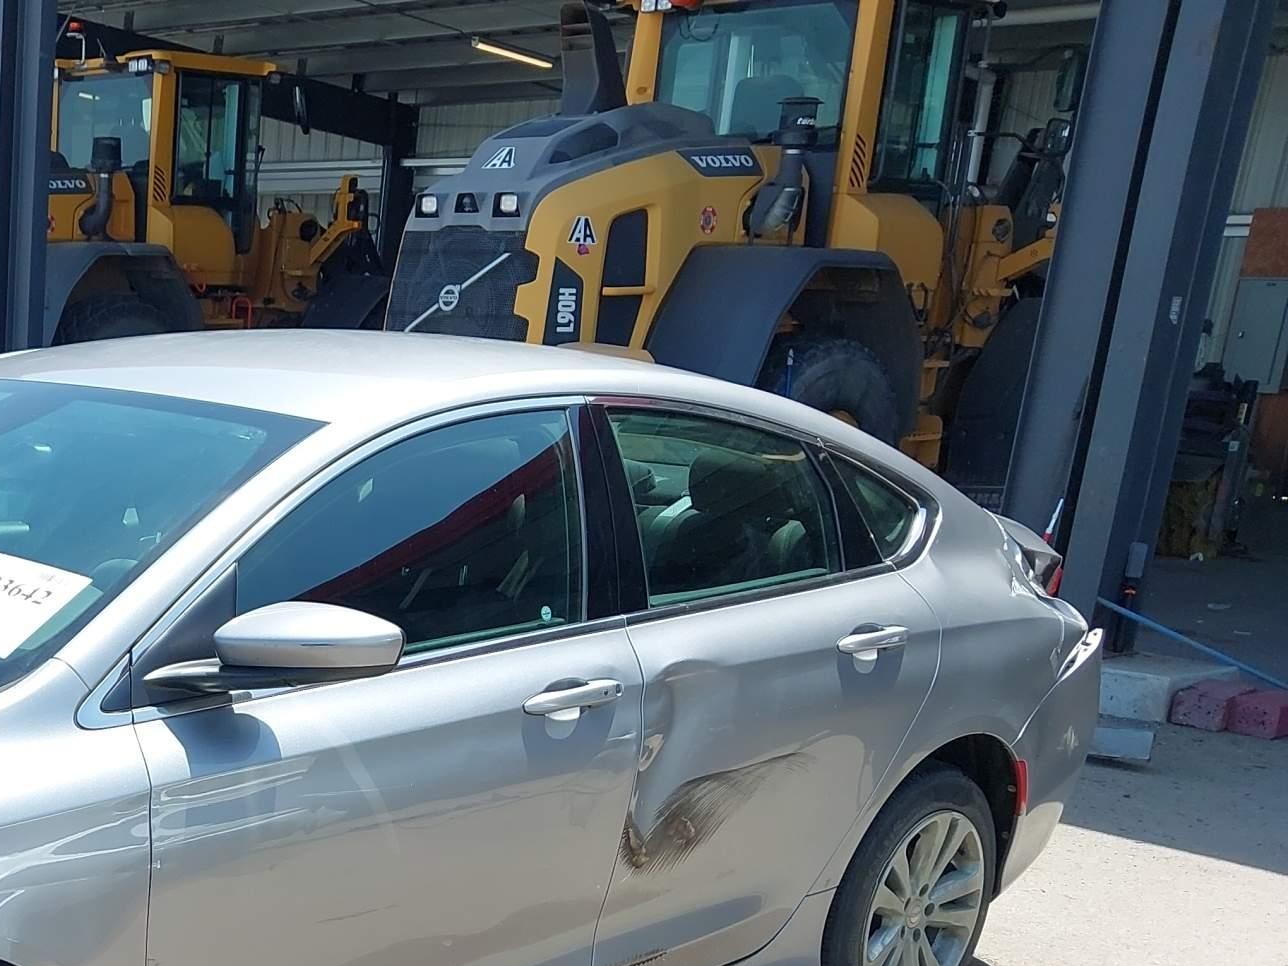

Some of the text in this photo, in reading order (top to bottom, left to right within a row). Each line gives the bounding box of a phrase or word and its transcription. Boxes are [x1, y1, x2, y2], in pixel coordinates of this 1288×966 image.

[691, 155, 753, 167] VOLVO
[48, 179, 86, 189] OLVO
[556, 287, 577, 333] L90H
